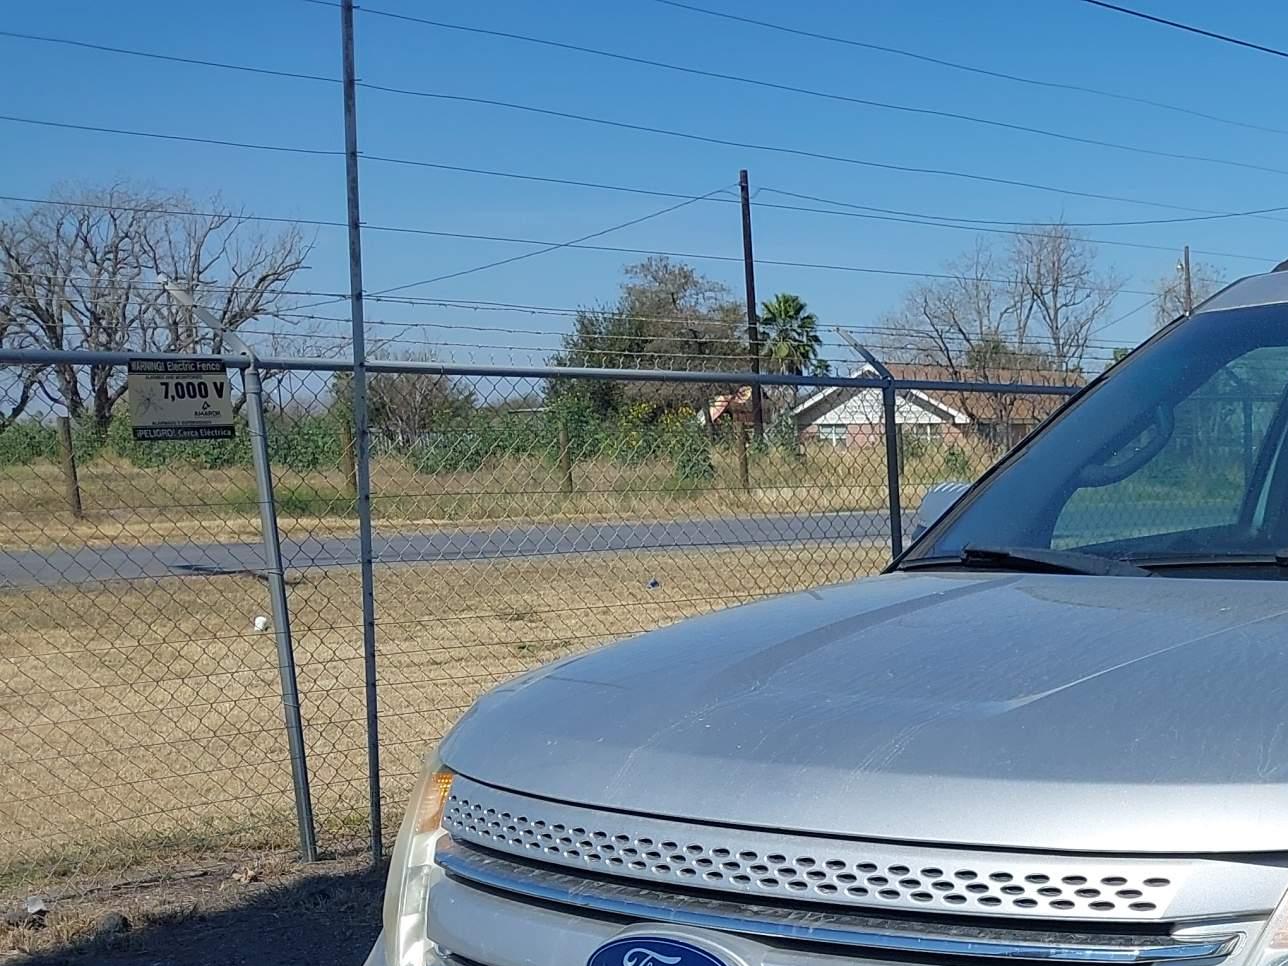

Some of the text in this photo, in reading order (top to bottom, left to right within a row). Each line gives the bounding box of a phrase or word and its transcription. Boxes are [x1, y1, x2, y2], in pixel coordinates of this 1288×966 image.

[167, 360, 196, 371] Electric
[197, 360, 221, 371] Fence
[160, 381, 225, 402] 7,000 V
[178, 428, 199, 437] Cerca
